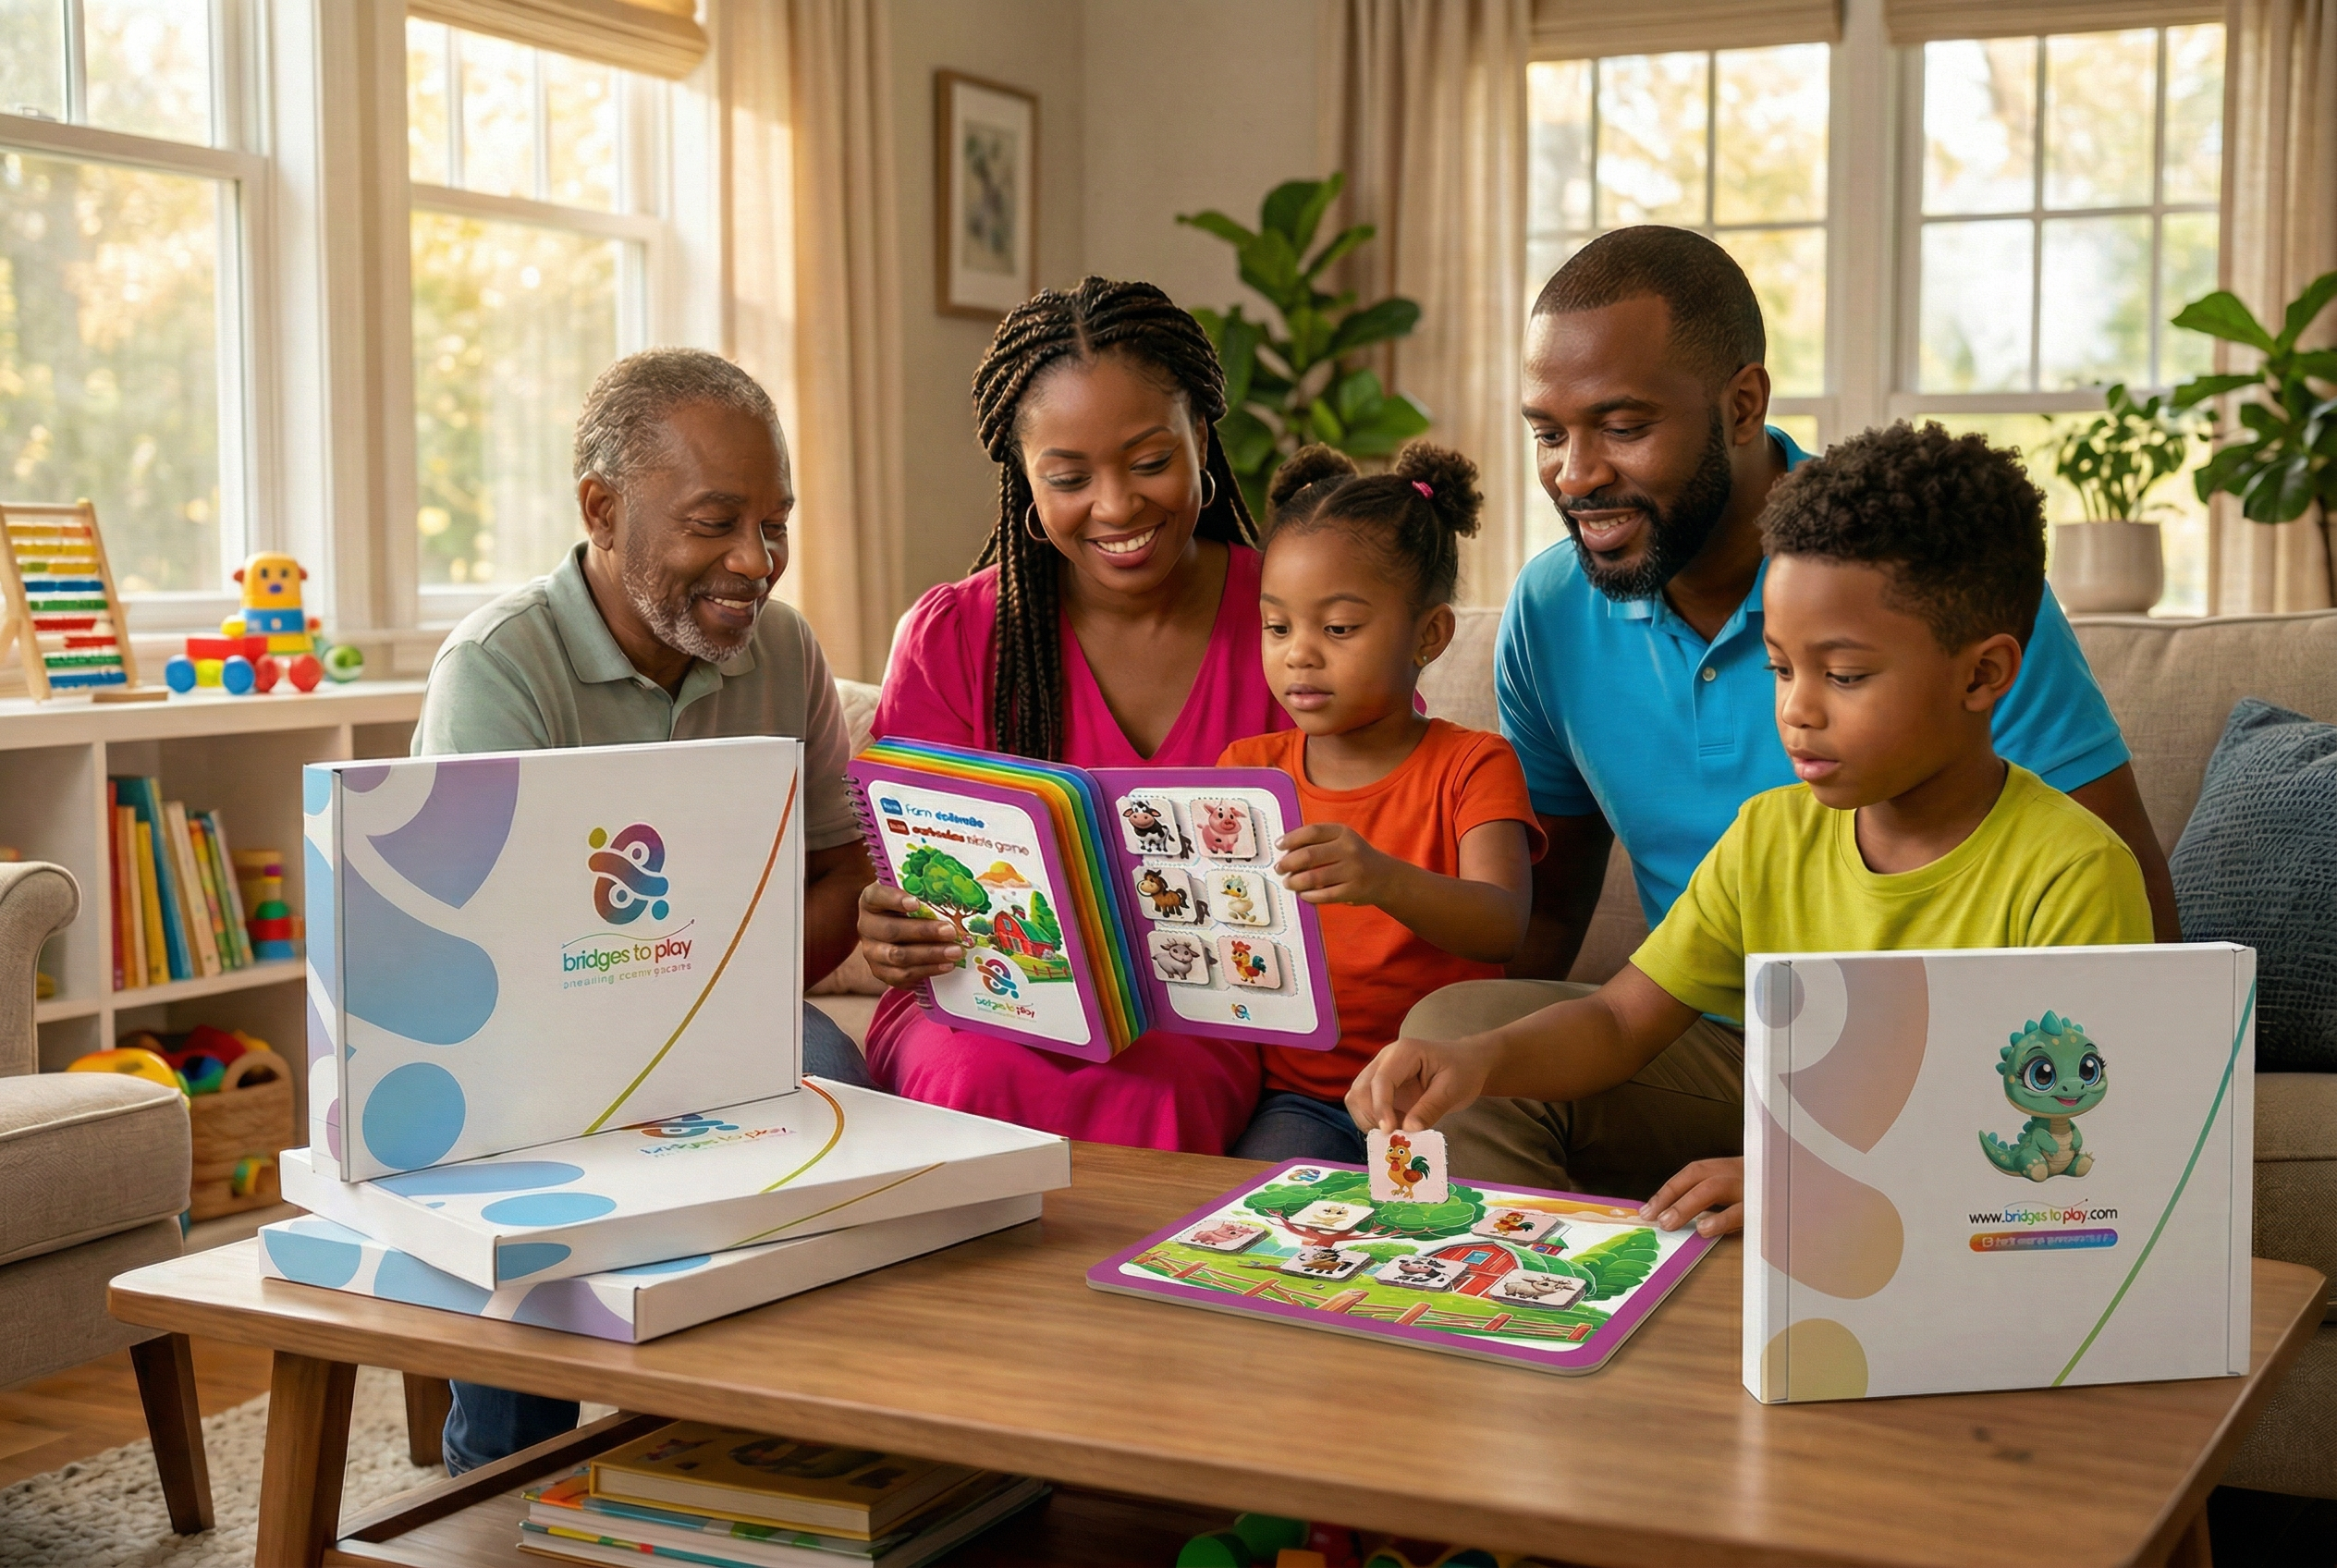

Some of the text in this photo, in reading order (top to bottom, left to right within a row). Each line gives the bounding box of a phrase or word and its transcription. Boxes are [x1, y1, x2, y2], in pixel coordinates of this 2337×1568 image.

[563, 938, 692, 972] bridges to play
